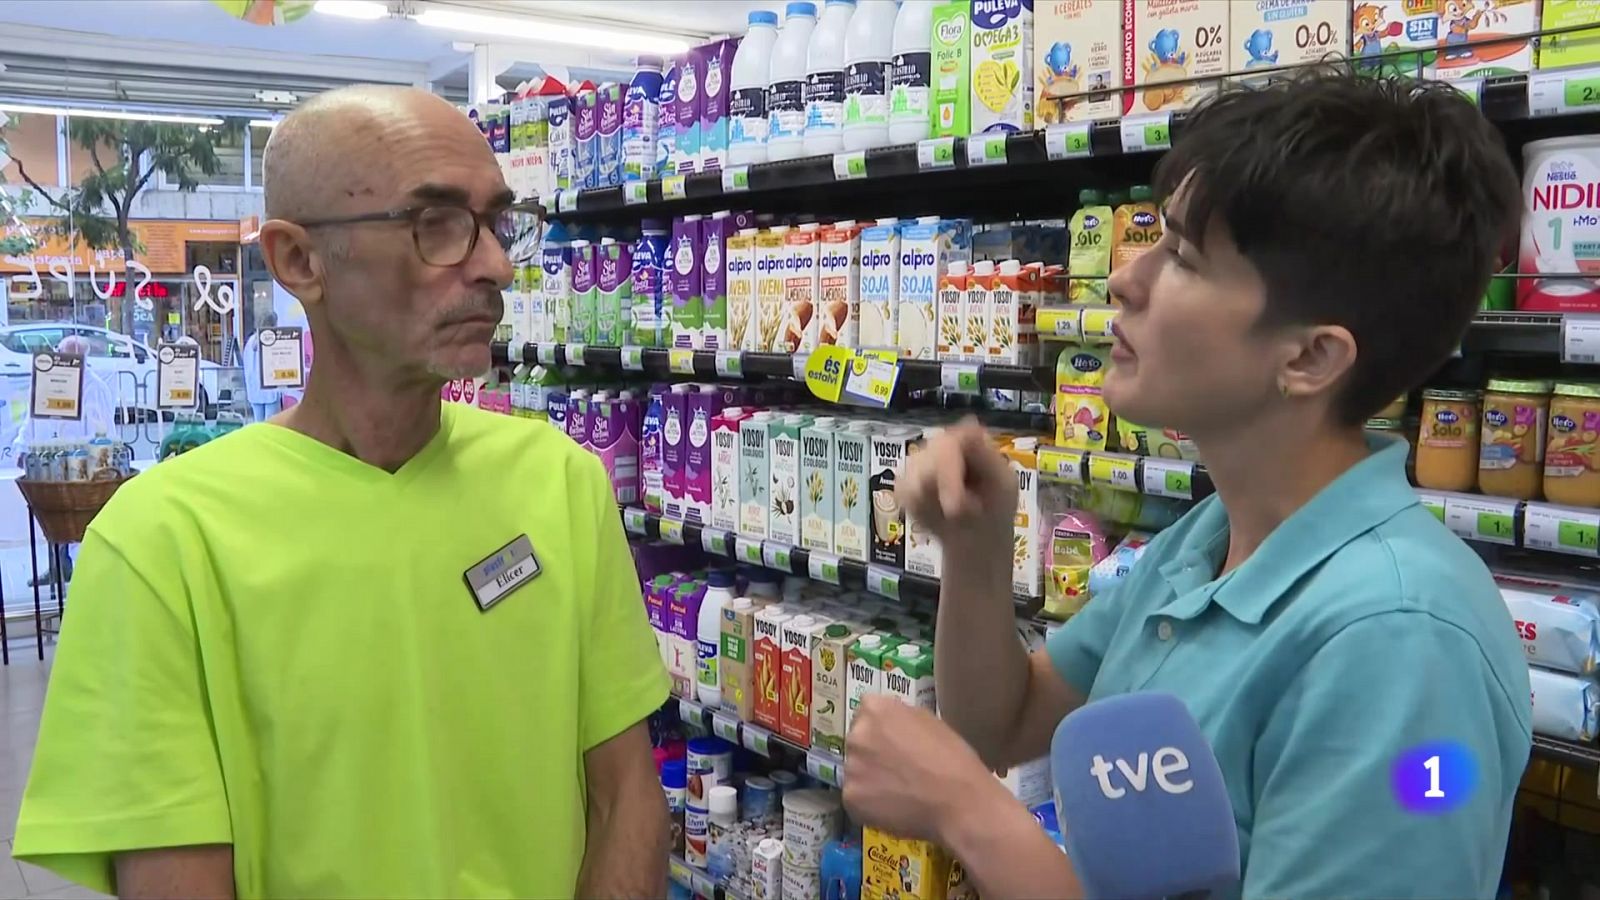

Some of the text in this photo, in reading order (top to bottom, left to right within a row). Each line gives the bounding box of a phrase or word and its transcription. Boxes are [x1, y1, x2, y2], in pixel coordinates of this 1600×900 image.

[941, 25, 962, 36] Flora
[1410, 19, 1434, 32] SIN
[1195, 25, 1222, 48] 0%
[1125, 32, 1133, 80] FORMATO
[1548, 217, 1562, 250] 1
[729, 256, 752, 276] alpro
[758, 255, 784, 274] alpro
[786, 252, 812, 272] alpro
[822, 251, 848, 272] alpro
[862, 249, 890, 270] alpro
[902, 248, 934, 270] alpro
[862, 276, 889, 294] SOJA
[902, 276, 934, 294] SOJA
[941, 291, 960, 304] YOSOY
[968, 291, 987, 304] YOSOY
[993, 291, 1013, 304] YOSOY
[824, 355, 840, 376] és
[1073, 357, 1100, 368] Hero
[808, 369, 838, 385] estalvi
[742, 429, 764, 448] YOSOY
[1432, 424, 1462, 437] Solo
[715, 432, 734, 449] YOSOY
[775, 440, 794, 458] YOSOY
[803, 437, 828, 458] YOSOY
[874, 441, 902, 459] YOSOY
[838, 440, 864, 462] YOSOY
[756, 619, 778, 638] YOSOY
[784, 629, 807, 649] YOSOY
[817, 673, 838, 686] SOJA
[850, 663, 874, 686] YOSOY
[887, 672, 911, 696] YOSOY
[1090, 746, 1194, 800] tve
